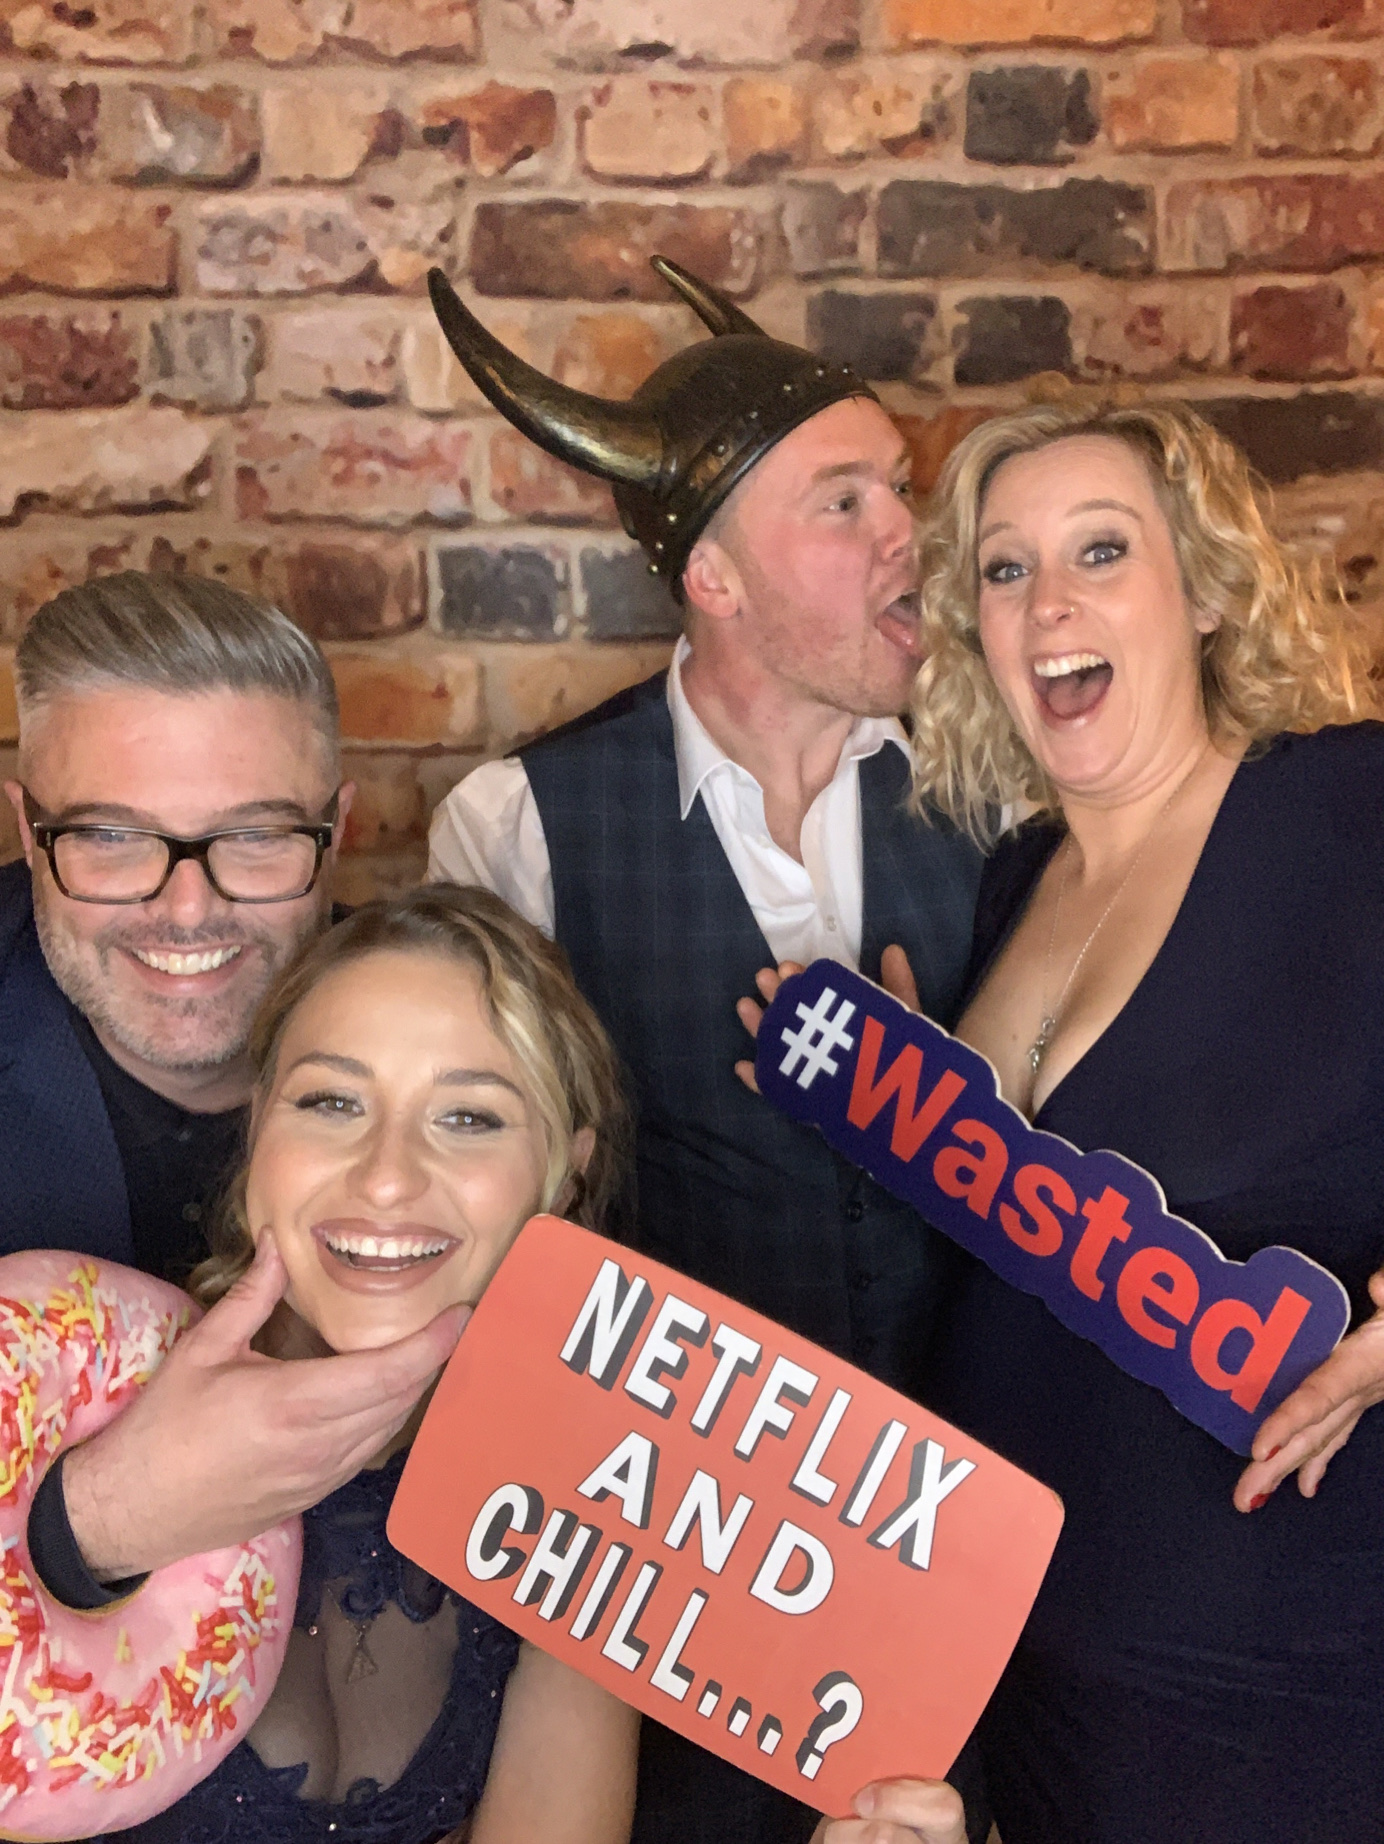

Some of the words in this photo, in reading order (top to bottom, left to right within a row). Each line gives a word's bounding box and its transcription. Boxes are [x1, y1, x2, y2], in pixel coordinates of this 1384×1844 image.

[779, 987, 1312, 1412] #Wasted
[559, 1258, 978, 1571] NETFLIX
[577, 1431, 834, 1615] AND
